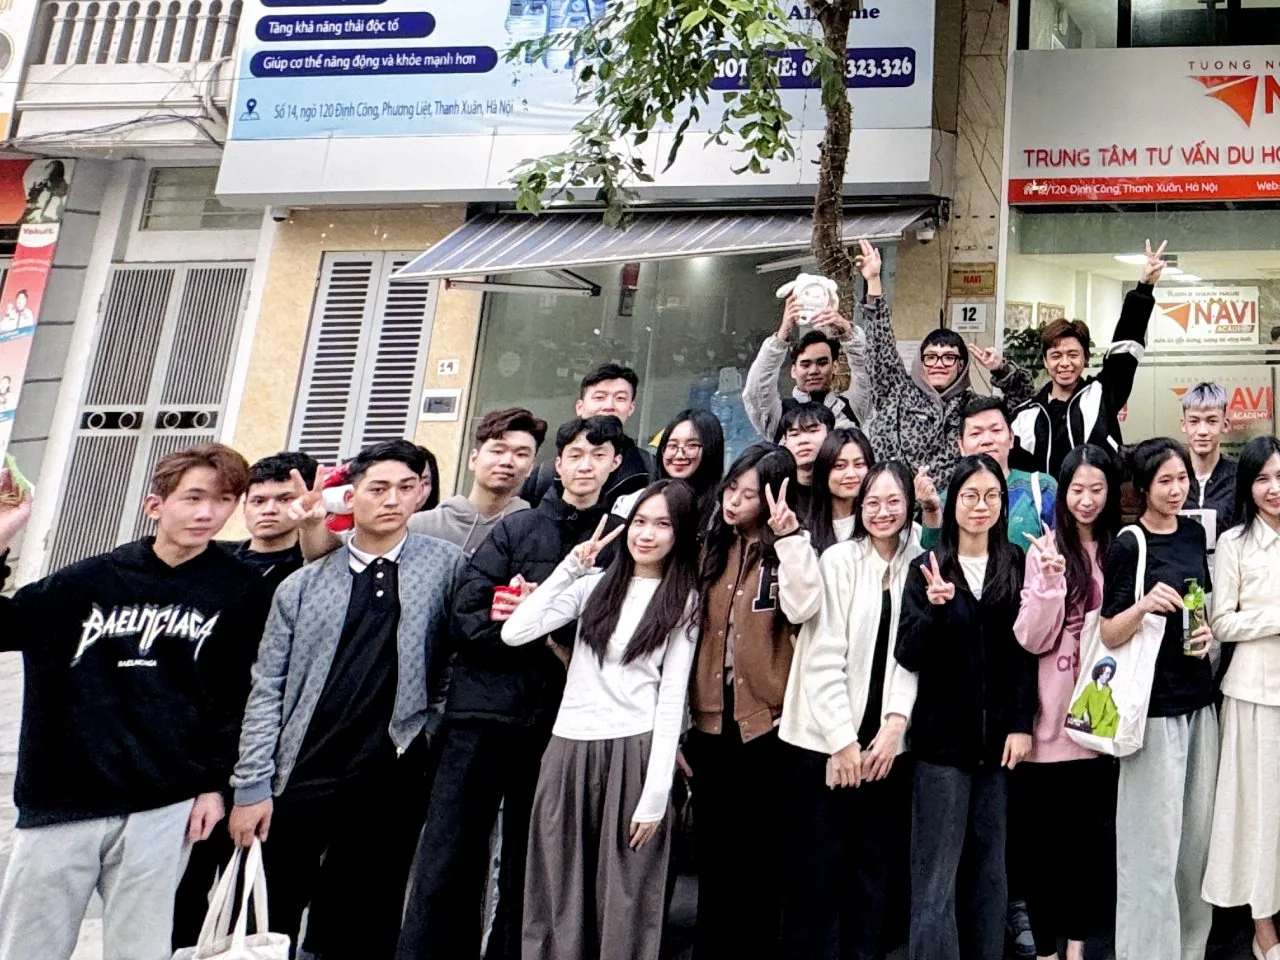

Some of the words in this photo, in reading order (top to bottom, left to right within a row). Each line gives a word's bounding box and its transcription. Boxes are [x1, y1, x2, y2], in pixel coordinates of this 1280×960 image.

[268, 21, 294, 37] Tăng
[295, 20, 314, 33] khả
[315, 20, 342, 36] năng
[344, 18, 365, 33] thải
[365, 18, 386, 35] độc
[387, 16, 400, 32] tố
[263, 56, 288, 72] Giúp
[289, 57, 304, 69] cơ
[323, 55, 351, 71] năng
[352, 54, 380, 70] động
[381, 53, 394, 67] và
[395, 52, 422, 66] khỏe
[423, 51, 453, 69] mạnh
[454, 51, 477, 66] hơn
[1188, 60, 1251, 71] TUONG
[273, 102, 287, 120] Số
[287, 103, 299, 120] 14,
[299, 103, 317, 122] ngõ
[319, 103, 334, 118] 120
[334, 102, 355, 120] Định
[356, 102, 380, 121] Công,
[382, 101, 414, 120] Phương
[434, 100, 460, 116] Thanh
[461, 100, 485, 117] Xuân,
[486, 99, 497, 115] Hà
[499, 99, 514, 118] Nội
[1023, 148, 1091, 168] TRUNG
[1098, 144, 1137, 167] TÂM
[1145, 144, 1173, 167] TƯ
[1181, 140, 1220, 166] VẤN
[1227, 145, 1254, 165] DU
[1069, 183, 1092, 195] Định
[1122, 183, 1154, 194] Thanh
[1156, 182, 1184, 194] Xuân,
[1185, 181, 1200, 192] Hà
[1201, 181, 1218, 194] Nội
[1256, 180, 1280, 191] Web:
[963, 275, 982, 284] NAVI
[961, 306, 977, 322] 12
[1194, 300, 1256, 325] NAVI
[439, 361, 454, 373] 14
[1229, 386, 1273, 410] AVI
[1232, 411, 1268, 419] ACADEMY
